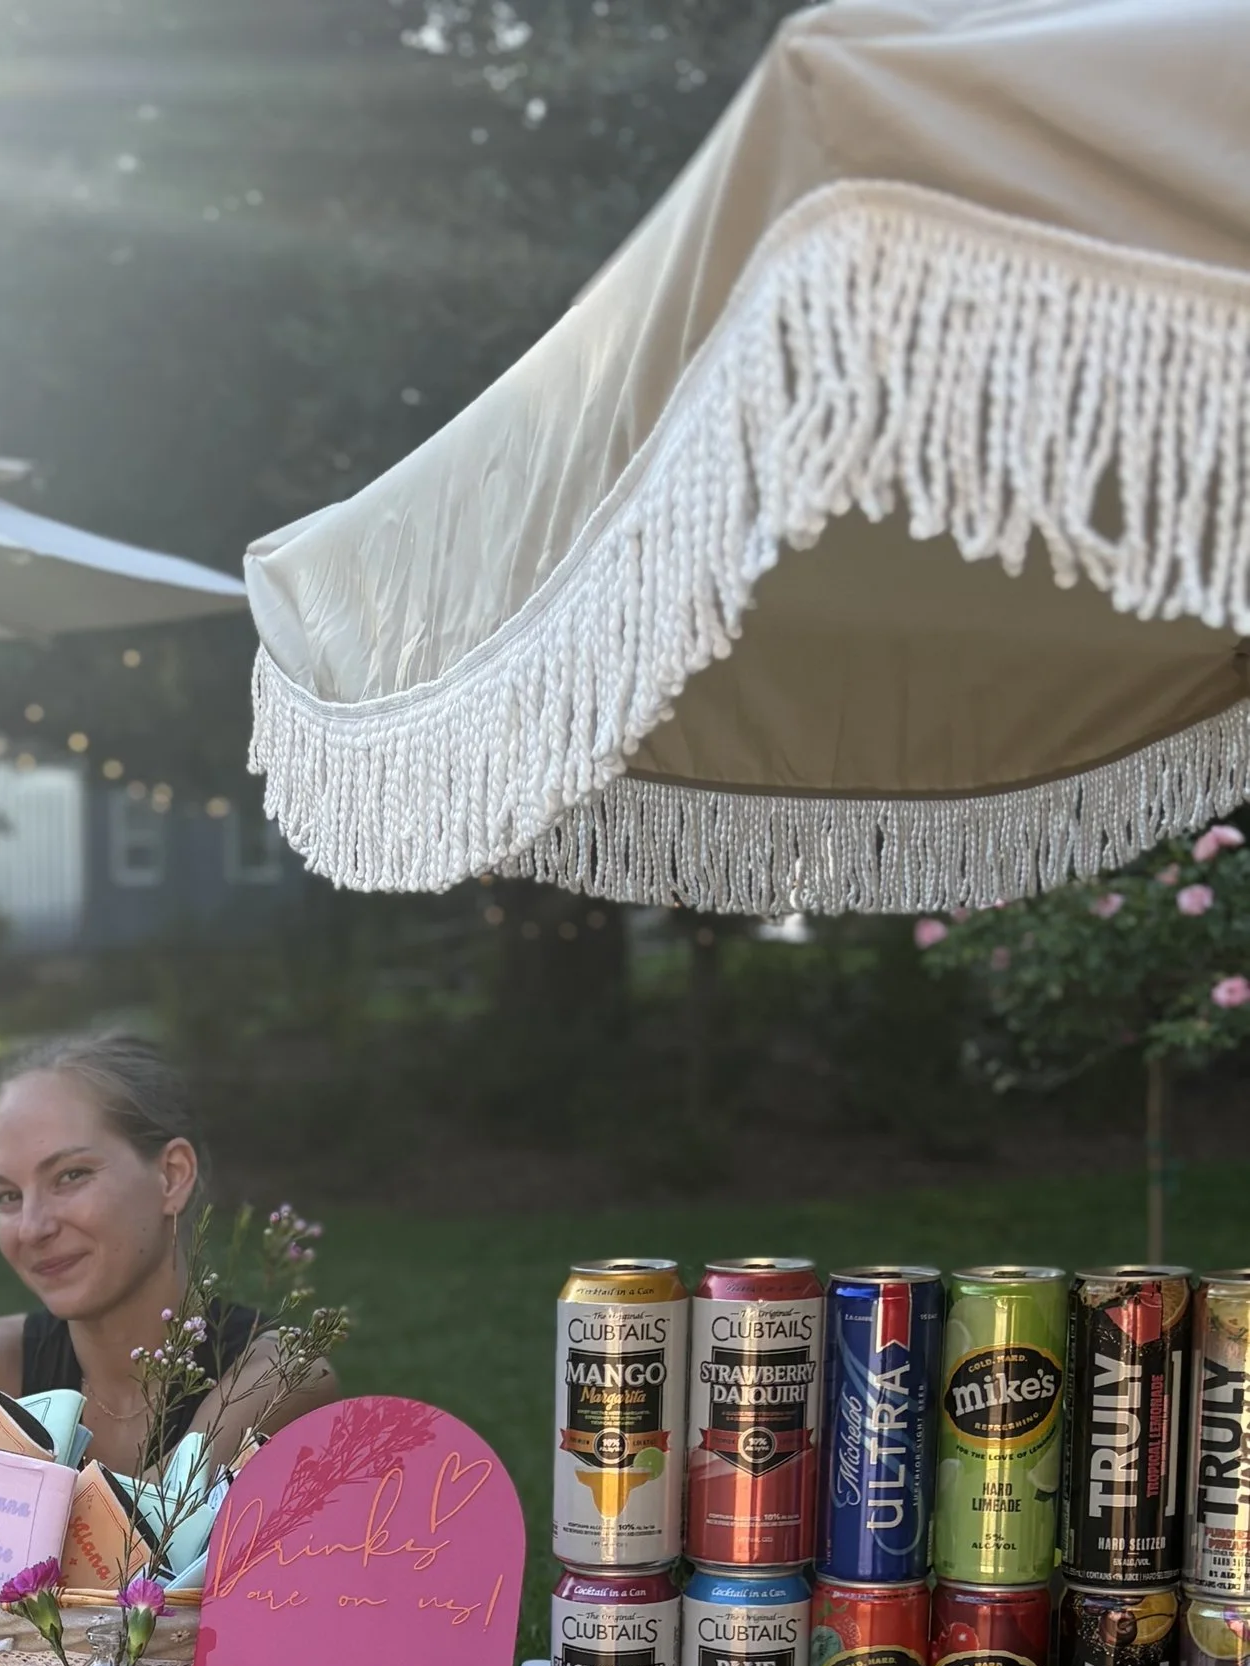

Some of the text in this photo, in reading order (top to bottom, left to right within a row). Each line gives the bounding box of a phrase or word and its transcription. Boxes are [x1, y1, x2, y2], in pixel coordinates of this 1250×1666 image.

[568, 1317, 667, 1343] CLUBTAILS
[711, 1315, 813, 1341] CLUBTAILS
[566, 1360, 667, 1387] MANGO
[700, 1361, 816, 1386] STRAWBERRY
[967, 1354, 1028, 1373] COLD. HARD.
[580, 1386, 647, 1411] Margarita
[712, 1384, 807, 1406] DAIQUIRI
[952, 1368, 1055, 1417] mike's
[866, 1361, 910, 1529] ULTRA
[916, 1418, 926, 1452] LIGHT
[1088, 1352, 1142, 1518] TRULY
[1146, 1374, 1164, 1498] TROPICAL LEMONADE
[1197, 1356, 1245, 1524] TRULY
[837, 1391, 863, 1506] Michelob
[971, 1449, 986, 1460] THE
[988, 1453, 1014, 1461] LOVE
[1016, 1451, 1028, 1459] OF
[982, 1482, 1013, 1497] HARD
[971, 1497, 1022, 1513] LIMEADE
[212, 1467, 451, 1598] Drinks
[1098, 1536, 1167, 1551] HARD SELTZER
[246, 1589, 308, 1610] are
[338, 1595, 388, 1607] on
[573, 1585, 609, 1597] Cocktail
[629, 1588, 647, 1597] Can
[711, 1587, 749, 1598] Cocktail
[769, 1589, 787, 1598] Can
[562, 1616, 658, 1644] CLUBTAILS
[698, 1617, 797, 1643] CLUBTAILS
